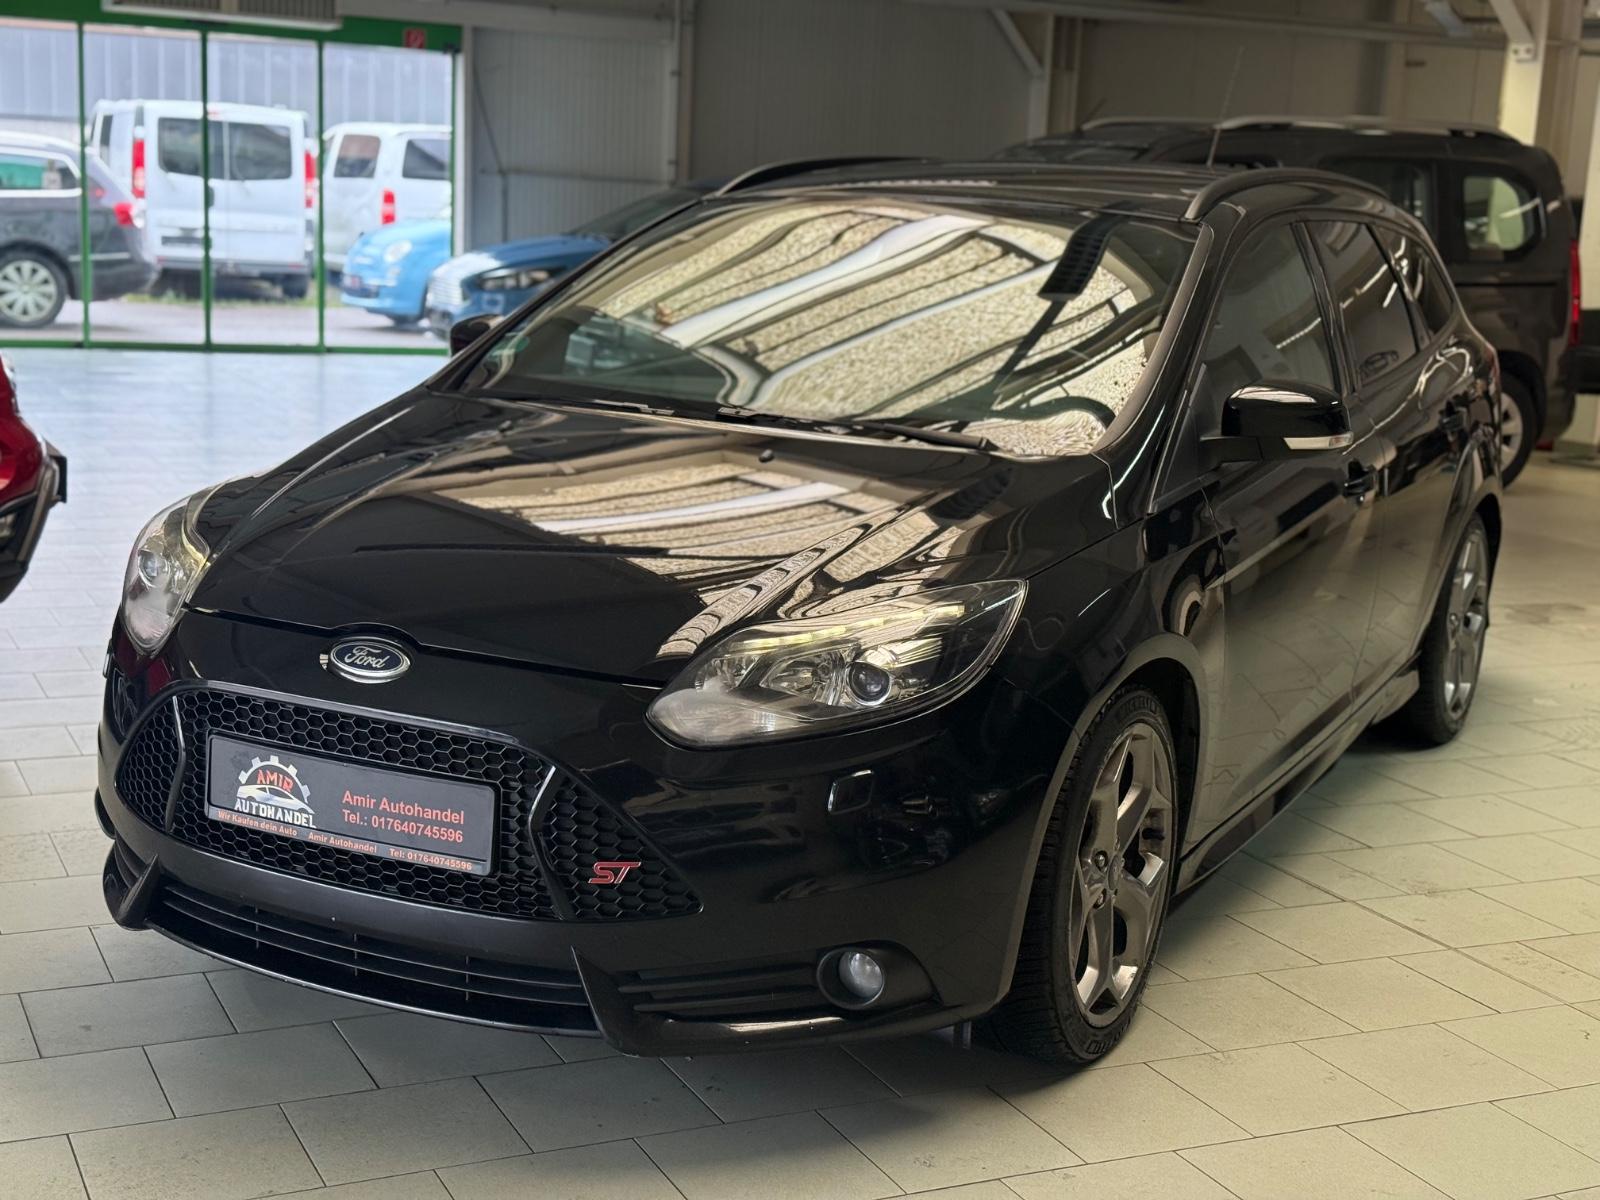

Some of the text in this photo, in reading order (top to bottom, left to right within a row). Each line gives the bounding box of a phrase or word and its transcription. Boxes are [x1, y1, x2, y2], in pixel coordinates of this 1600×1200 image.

[344, 645, 390, 668] Ford
[256, 768, 294, 793] AMIR
[234, 798, 317, 829] AUTOHANDEL
[342, 790, 465, 825] Amir Autohandel
[218, 810, 473, 871] Wir Kaufen dein Auto Amir Autohandel Tel: 017640745596
[342, 809, 464, 843] Tel.: 017640745596
[587, 861, 641, 884] ST
